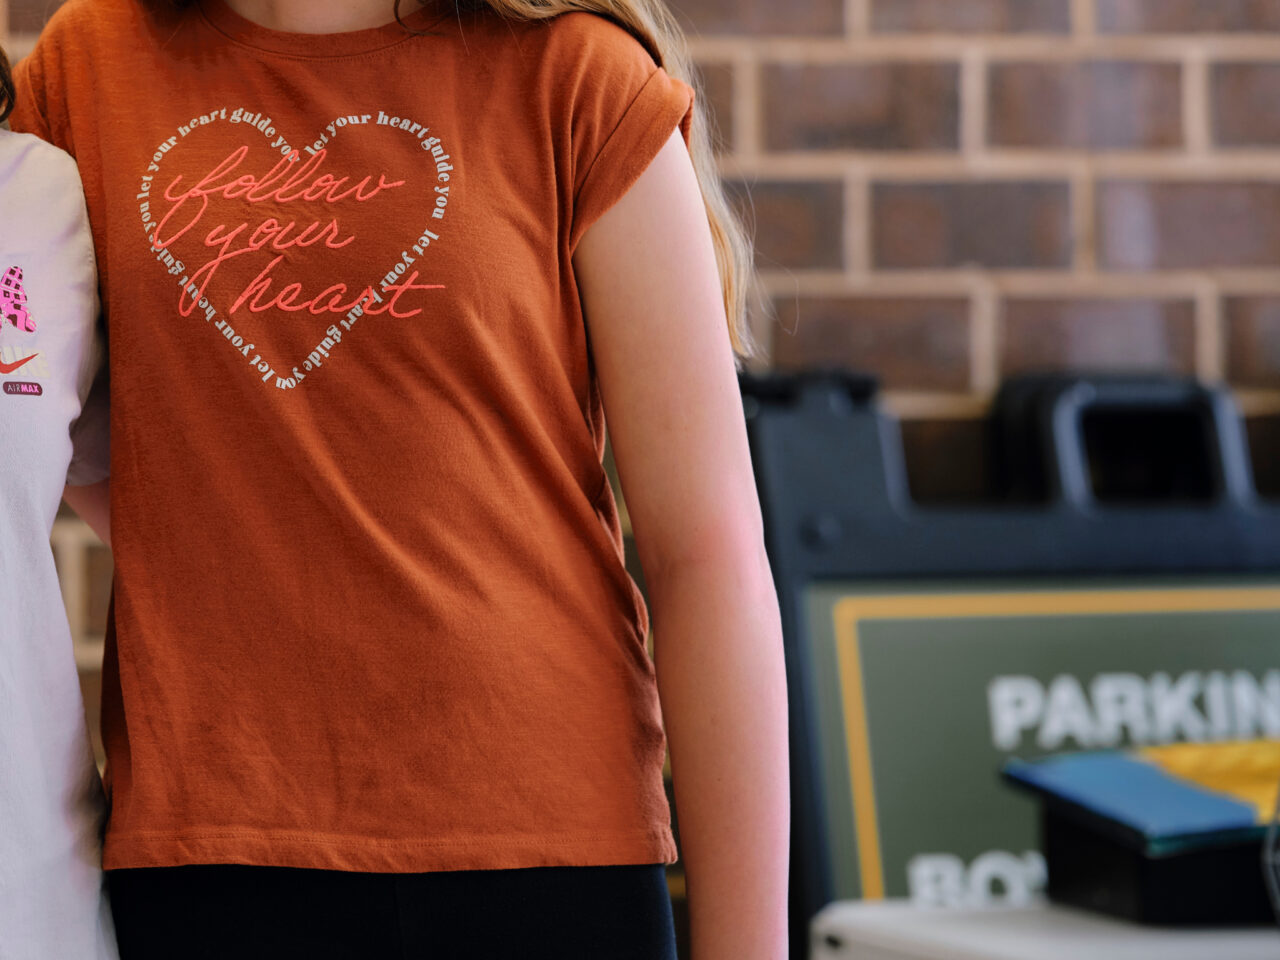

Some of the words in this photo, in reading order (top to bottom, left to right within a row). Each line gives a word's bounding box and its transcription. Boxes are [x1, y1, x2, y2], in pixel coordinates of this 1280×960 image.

[326, 114, 372, 137] your
[376, 110, 430, 139] heart
[136, 175, 154, 200] let
[147, 135, 179, 172] your
[177, 107, 227, 137] heart
[229, 107, 276, 138] guide
[303, 132, 329, 156] let
[420, 136, 454, 183] guide
[153, 145, 406, 250] follow
[433, 185, 450, 220] you
[140, 201, 157, 233] you
[412, 228, 440, 256] let
[178, 218, 355, 317] your
[379, 250, 416, 293] your
[229, 255, 446, 318] heart
[214, 319, 255, 357] your
[302, 324, 342, 372] guide
[248, 354, 276, 383] let
[275, 366, 307, 390] you
